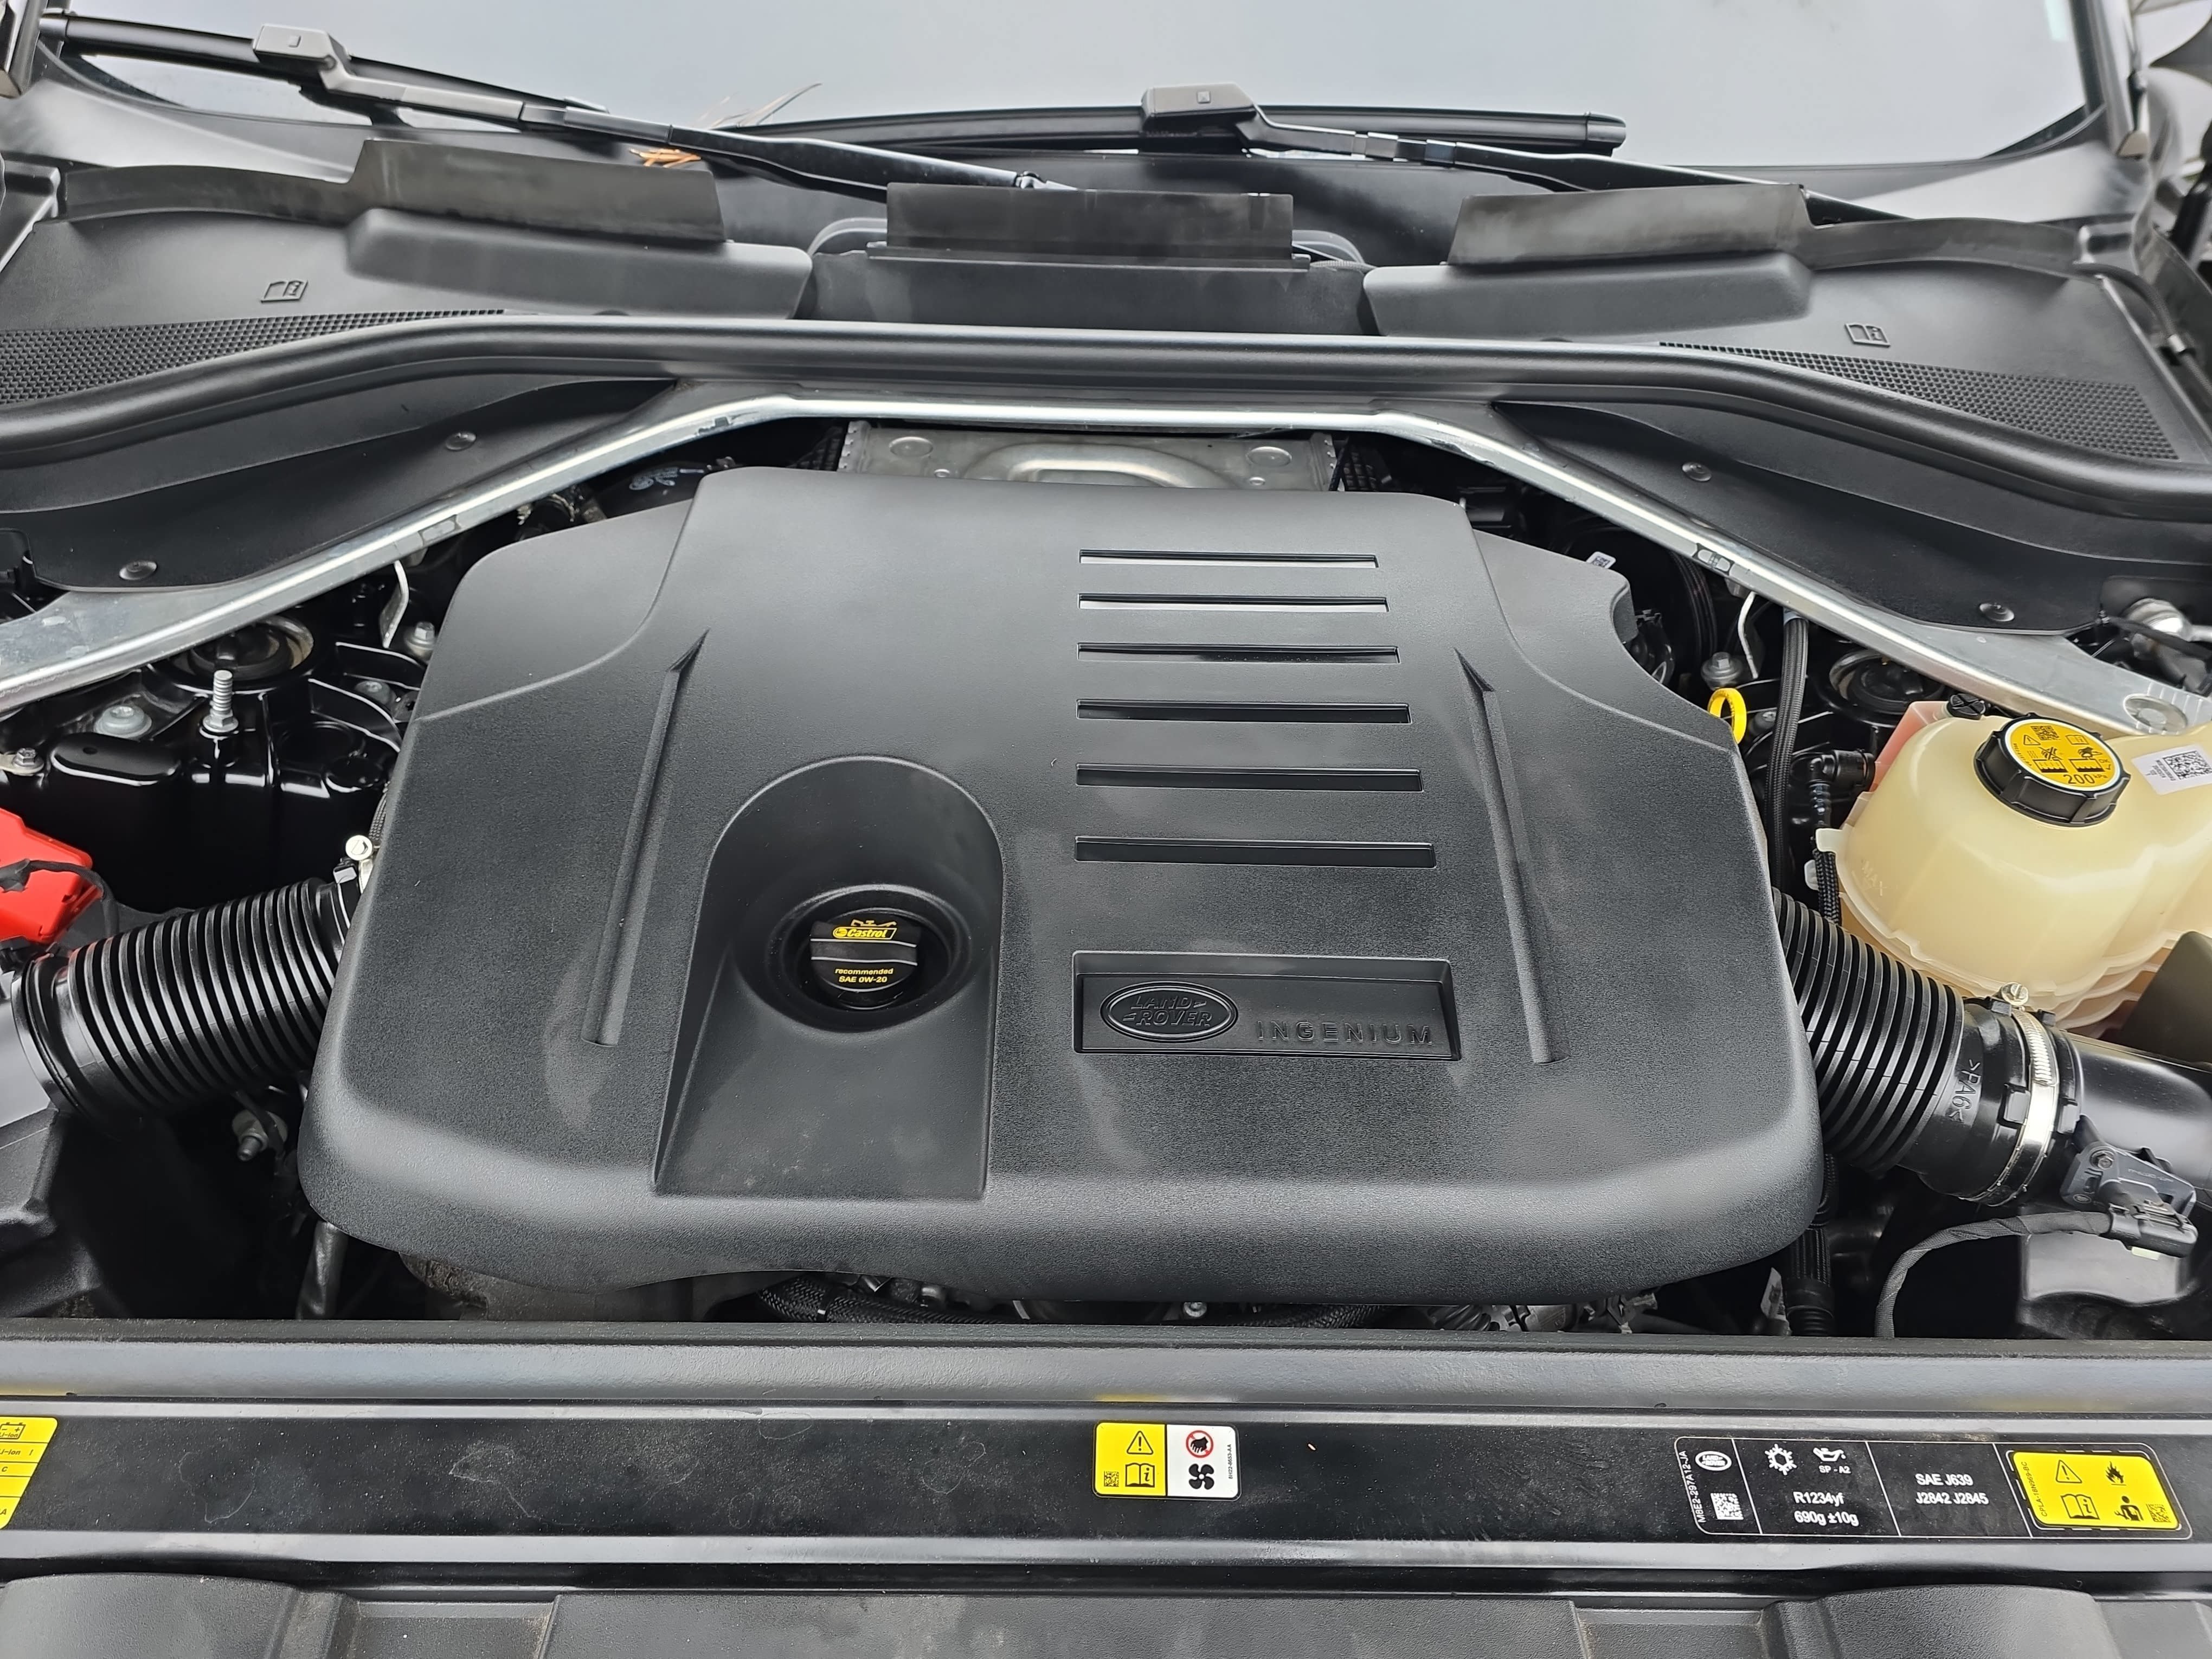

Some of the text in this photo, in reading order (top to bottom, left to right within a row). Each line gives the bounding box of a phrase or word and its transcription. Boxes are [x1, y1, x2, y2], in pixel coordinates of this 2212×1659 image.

[2063, 774, 2095, 784] 200
[847, 928, 888, 938] Castrol
[1131, 995, 1192, 1009] LAND
[1136, 1010, 1212, 1027] ROVER
[1257, 1020, 1433, 1045] INGENIUM
[1679, 1450, 1707, 1523] M8E2-297A12-JA
[1915, 1473, 1973, 1486] SAE J639
[2021, 1461, 2048, 1517] CPLA-18N969-BC
[1793, 1491, 1844, 1507] R1234yf
[1915, 1492, 1989, 1505] J2842 J2845
[1794, 1510, 1860, 1527] 690g ±10g
